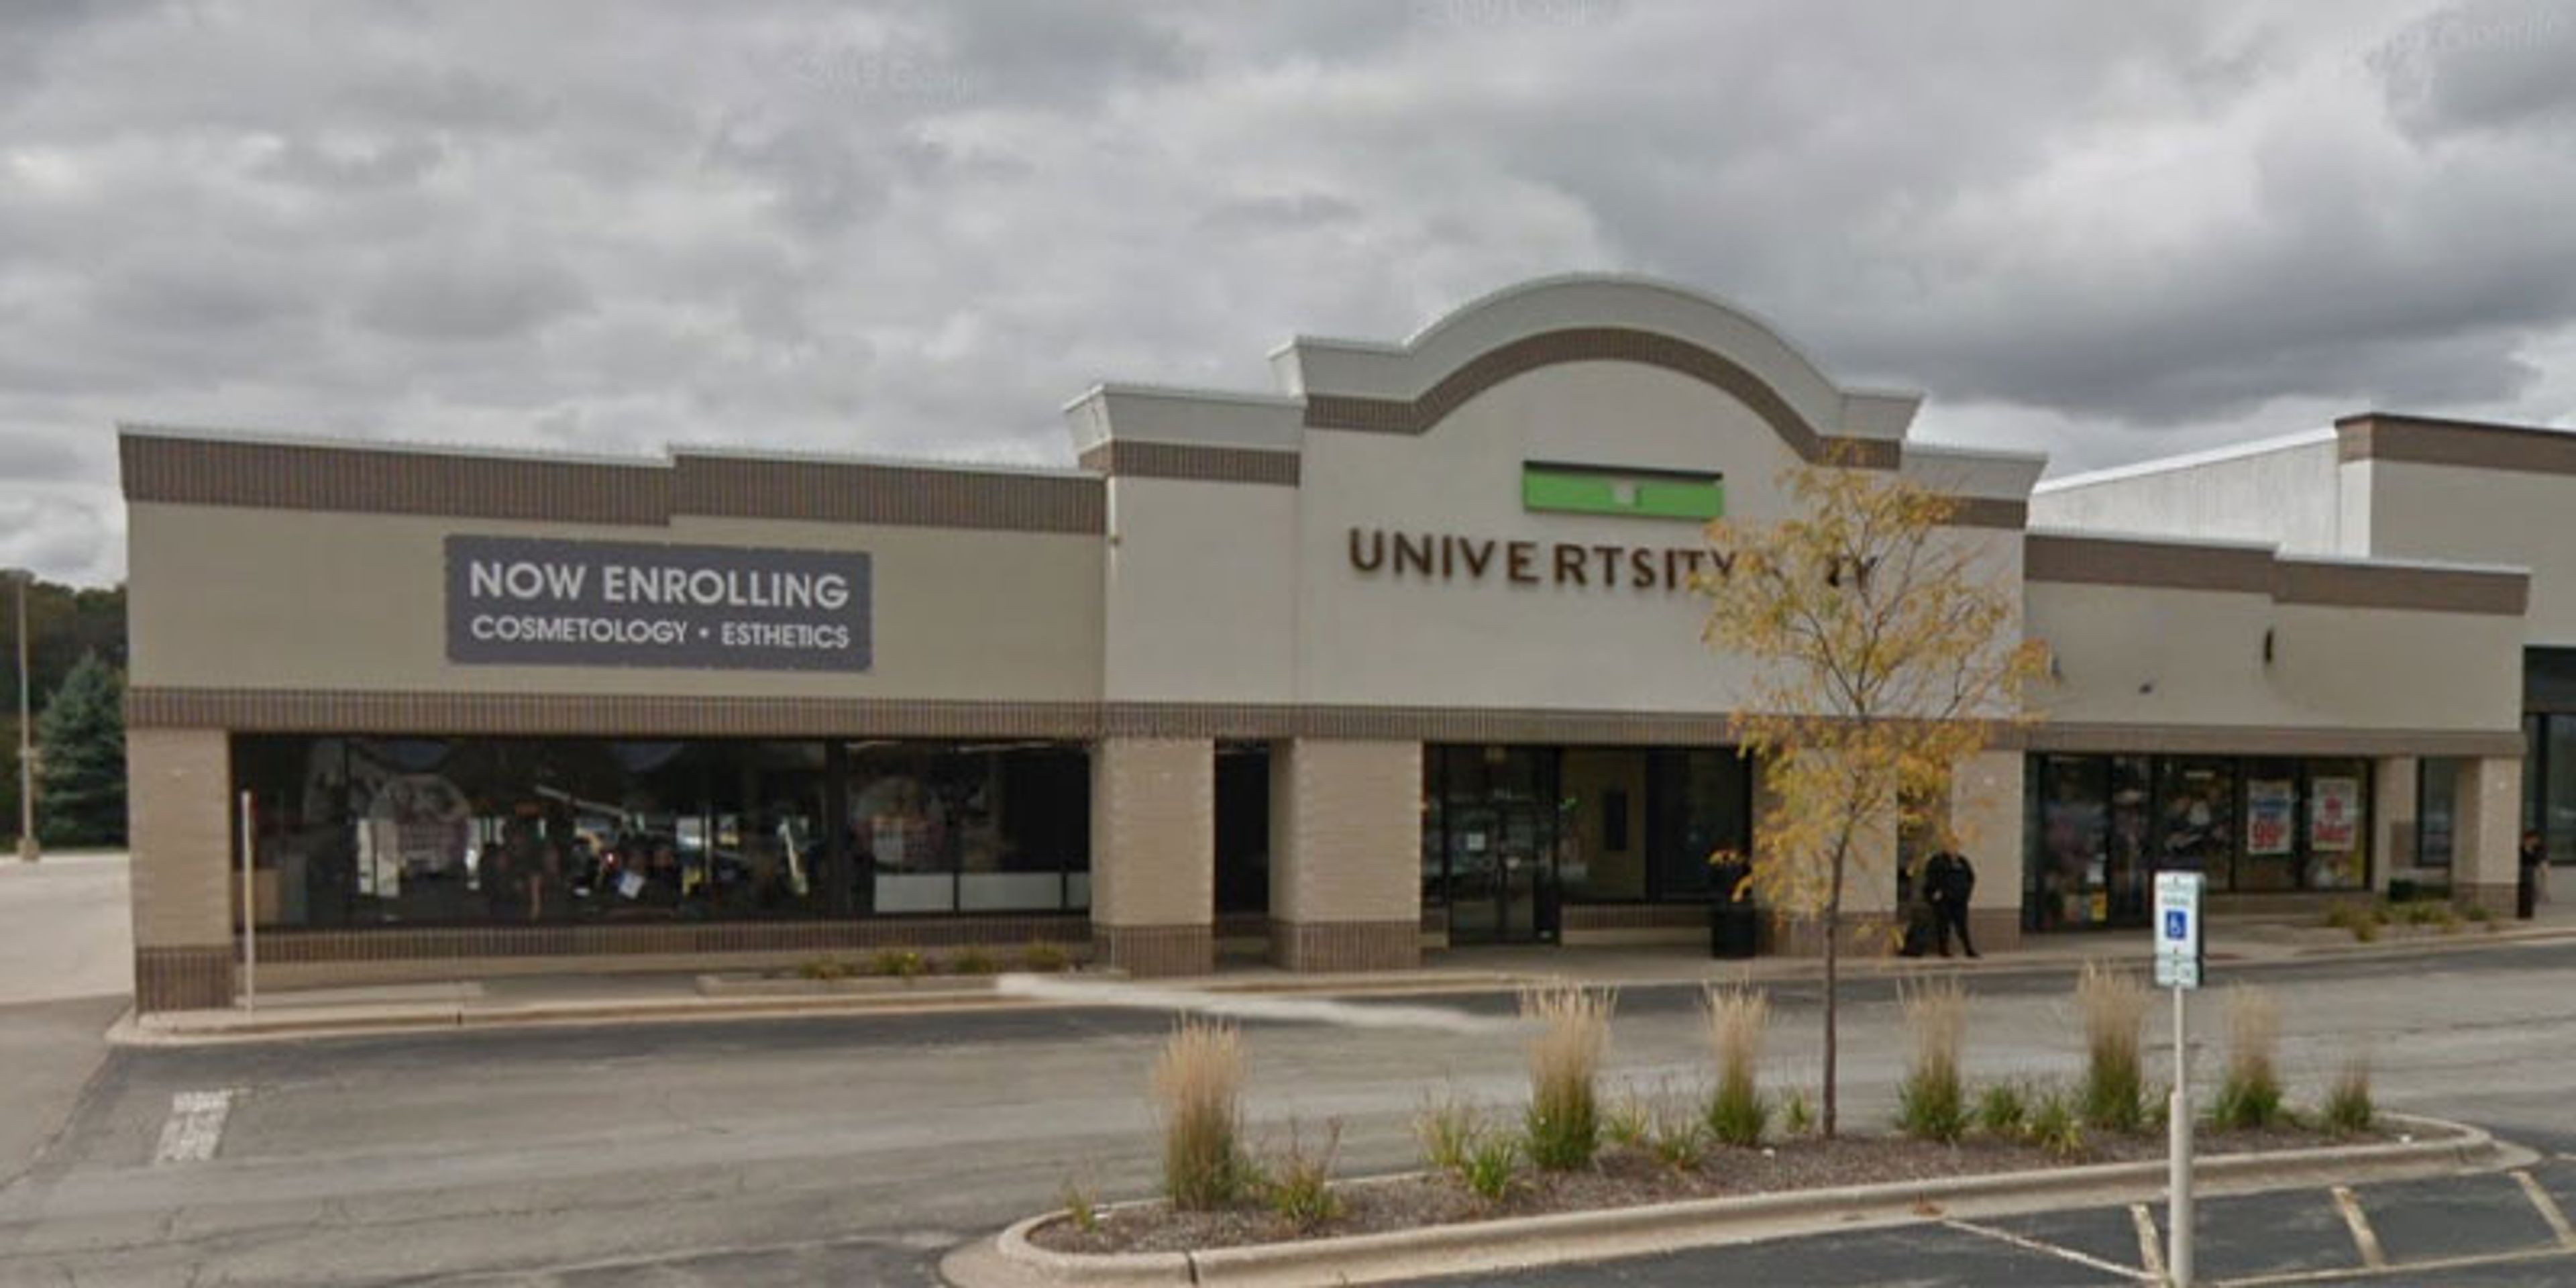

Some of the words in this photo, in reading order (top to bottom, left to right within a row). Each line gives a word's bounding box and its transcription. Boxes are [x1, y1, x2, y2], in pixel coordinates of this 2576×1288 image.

[470, 561, 586, 600] NOW
[604, 566, 849, 609] ENROLLING
[471, 614, 688, 643] COSMETOLOGY
[721, 621, 850, 649] ESTHETICS
